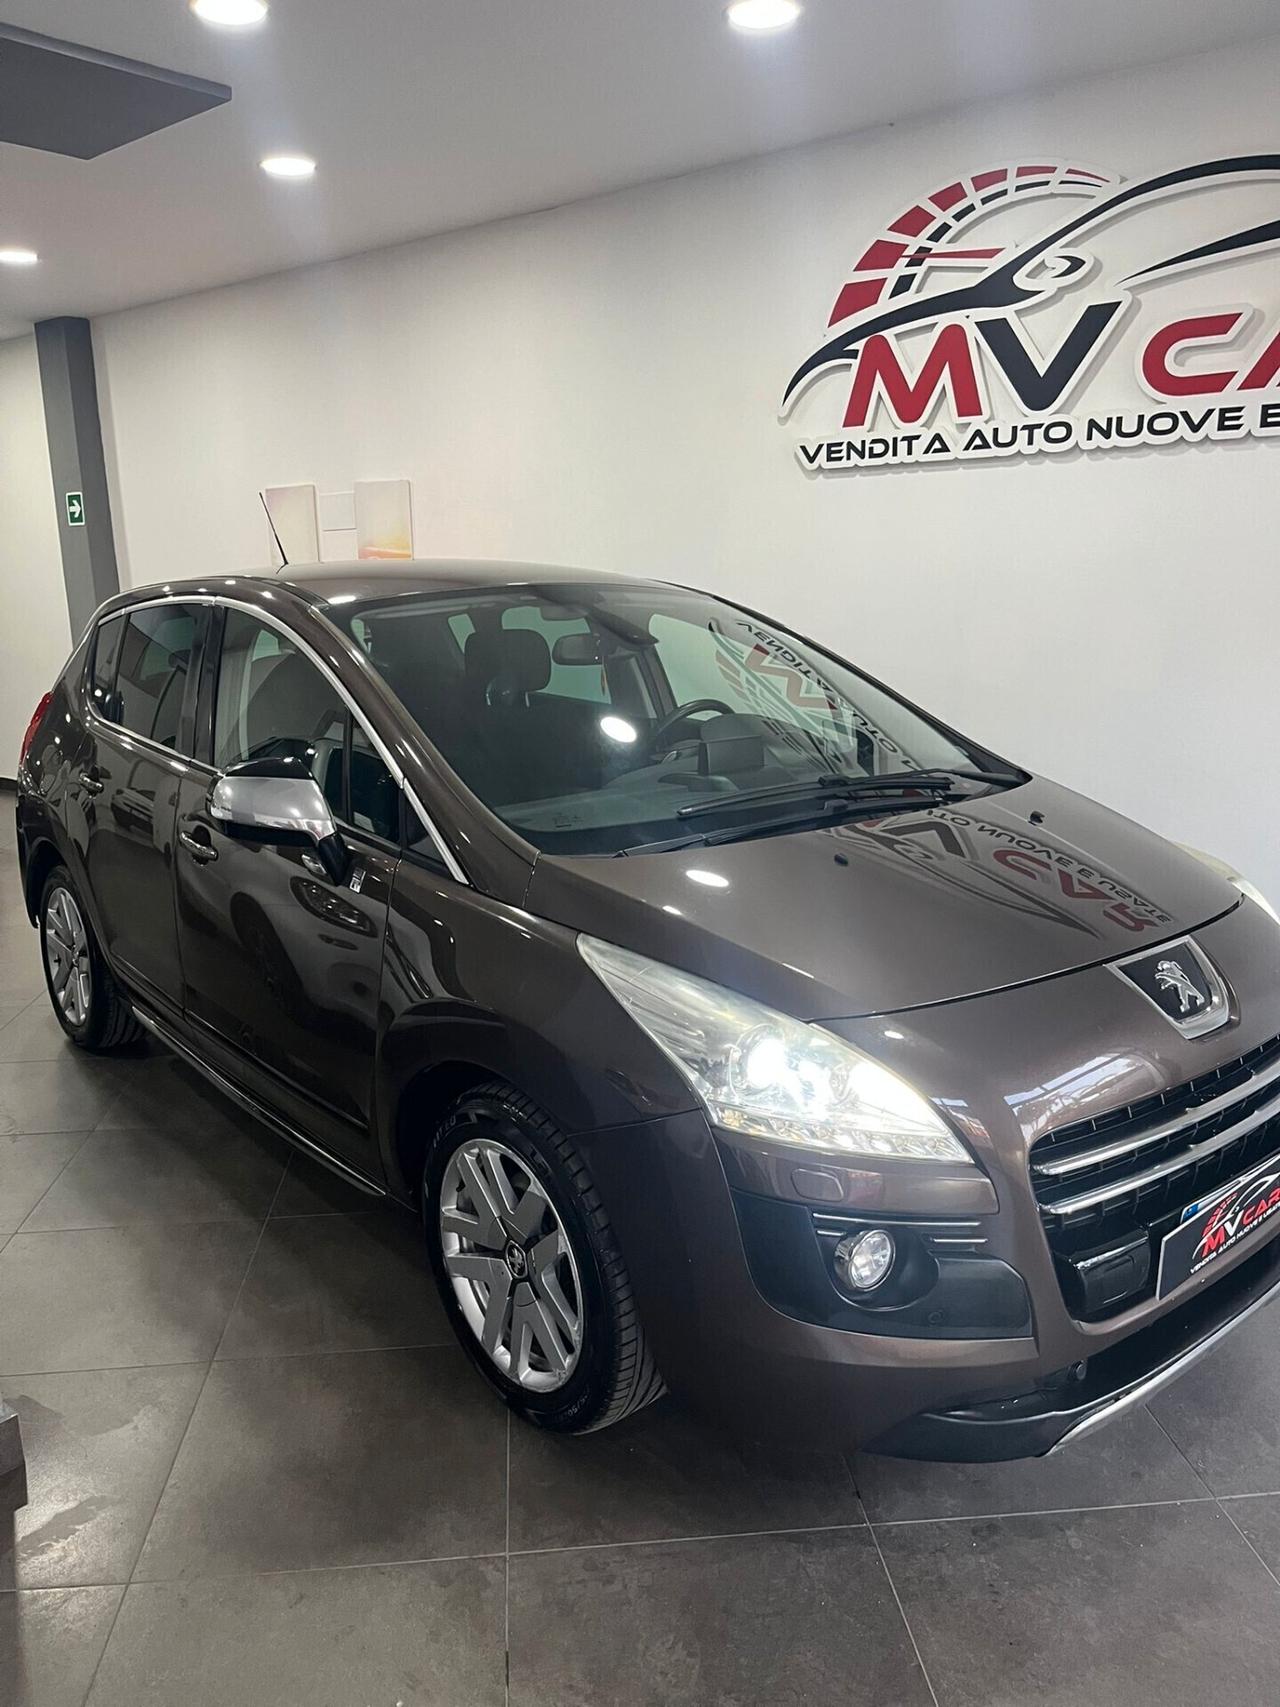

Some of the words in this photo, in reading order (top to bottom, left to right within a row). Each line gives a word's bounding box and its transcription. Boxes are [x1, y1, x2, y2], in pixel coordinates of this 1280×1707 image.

[842, 301, 1122, 428] MV
[799, 432, 951, 464] VENDITA
[962, 420, 1073, 452] AUTO
[1086, 405, 1246, 441] NUOVE
[1202, 1209, 1245, 1258] MV
